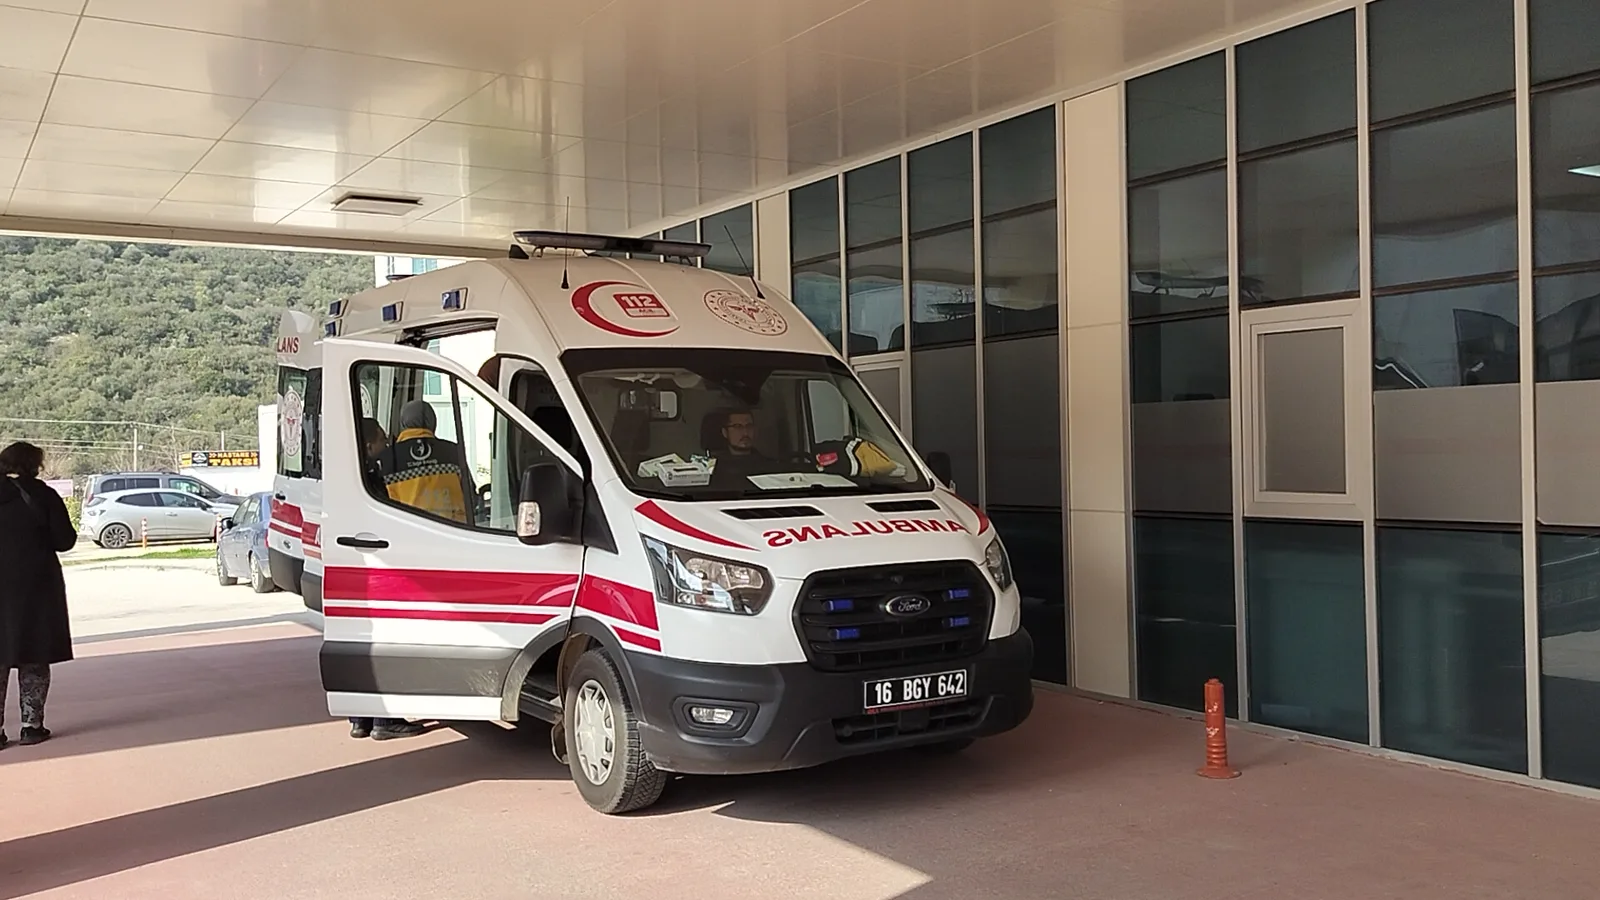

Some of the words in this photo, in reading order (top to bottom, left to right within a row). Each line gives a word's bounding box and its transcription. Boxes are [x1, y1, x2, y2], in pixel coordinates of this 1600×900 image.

[621, 295, 657, 307] 112
[277, 336, 299, 354] LANS
[897, 598, 922, 612] Ford
[874, 678, 893, 705] 16
[902, 676, 931, 702] BGY
[937, 672, 964, 697] 642
